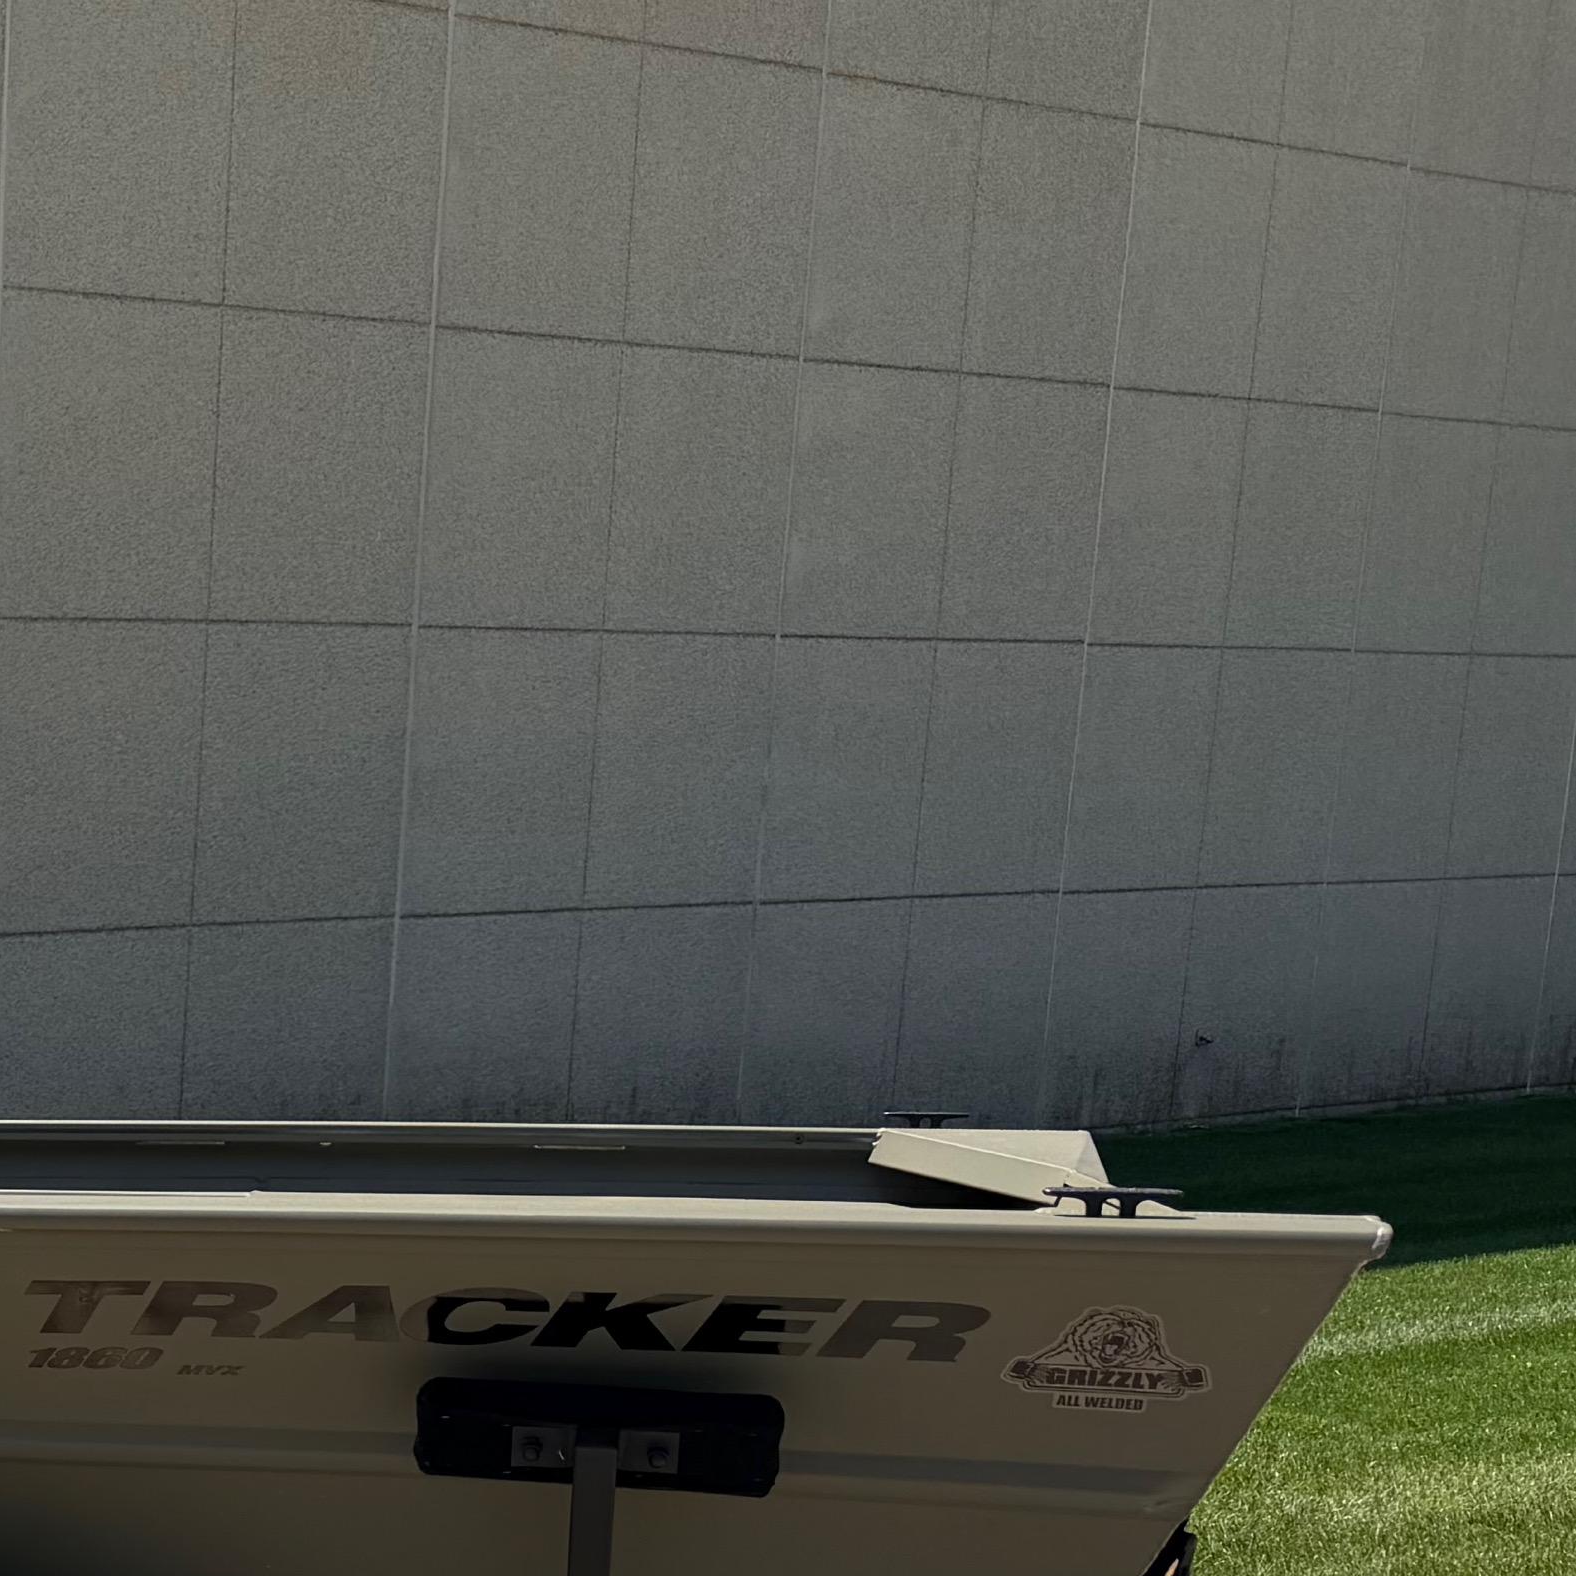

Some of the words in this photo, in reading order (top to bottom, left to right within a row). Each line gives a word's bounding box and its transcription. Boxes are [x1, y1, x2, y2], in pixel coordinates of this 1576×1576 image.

[24, 1279, 992, 1363] TRACKER
[27, 1346, 164, 1369] 1860
[1046, 1366, 1165, 1390] GRIZZLY
[1056, 1394, 1081, 1408] ALL
[1084, 1394, 1144, 1411] WELDED
